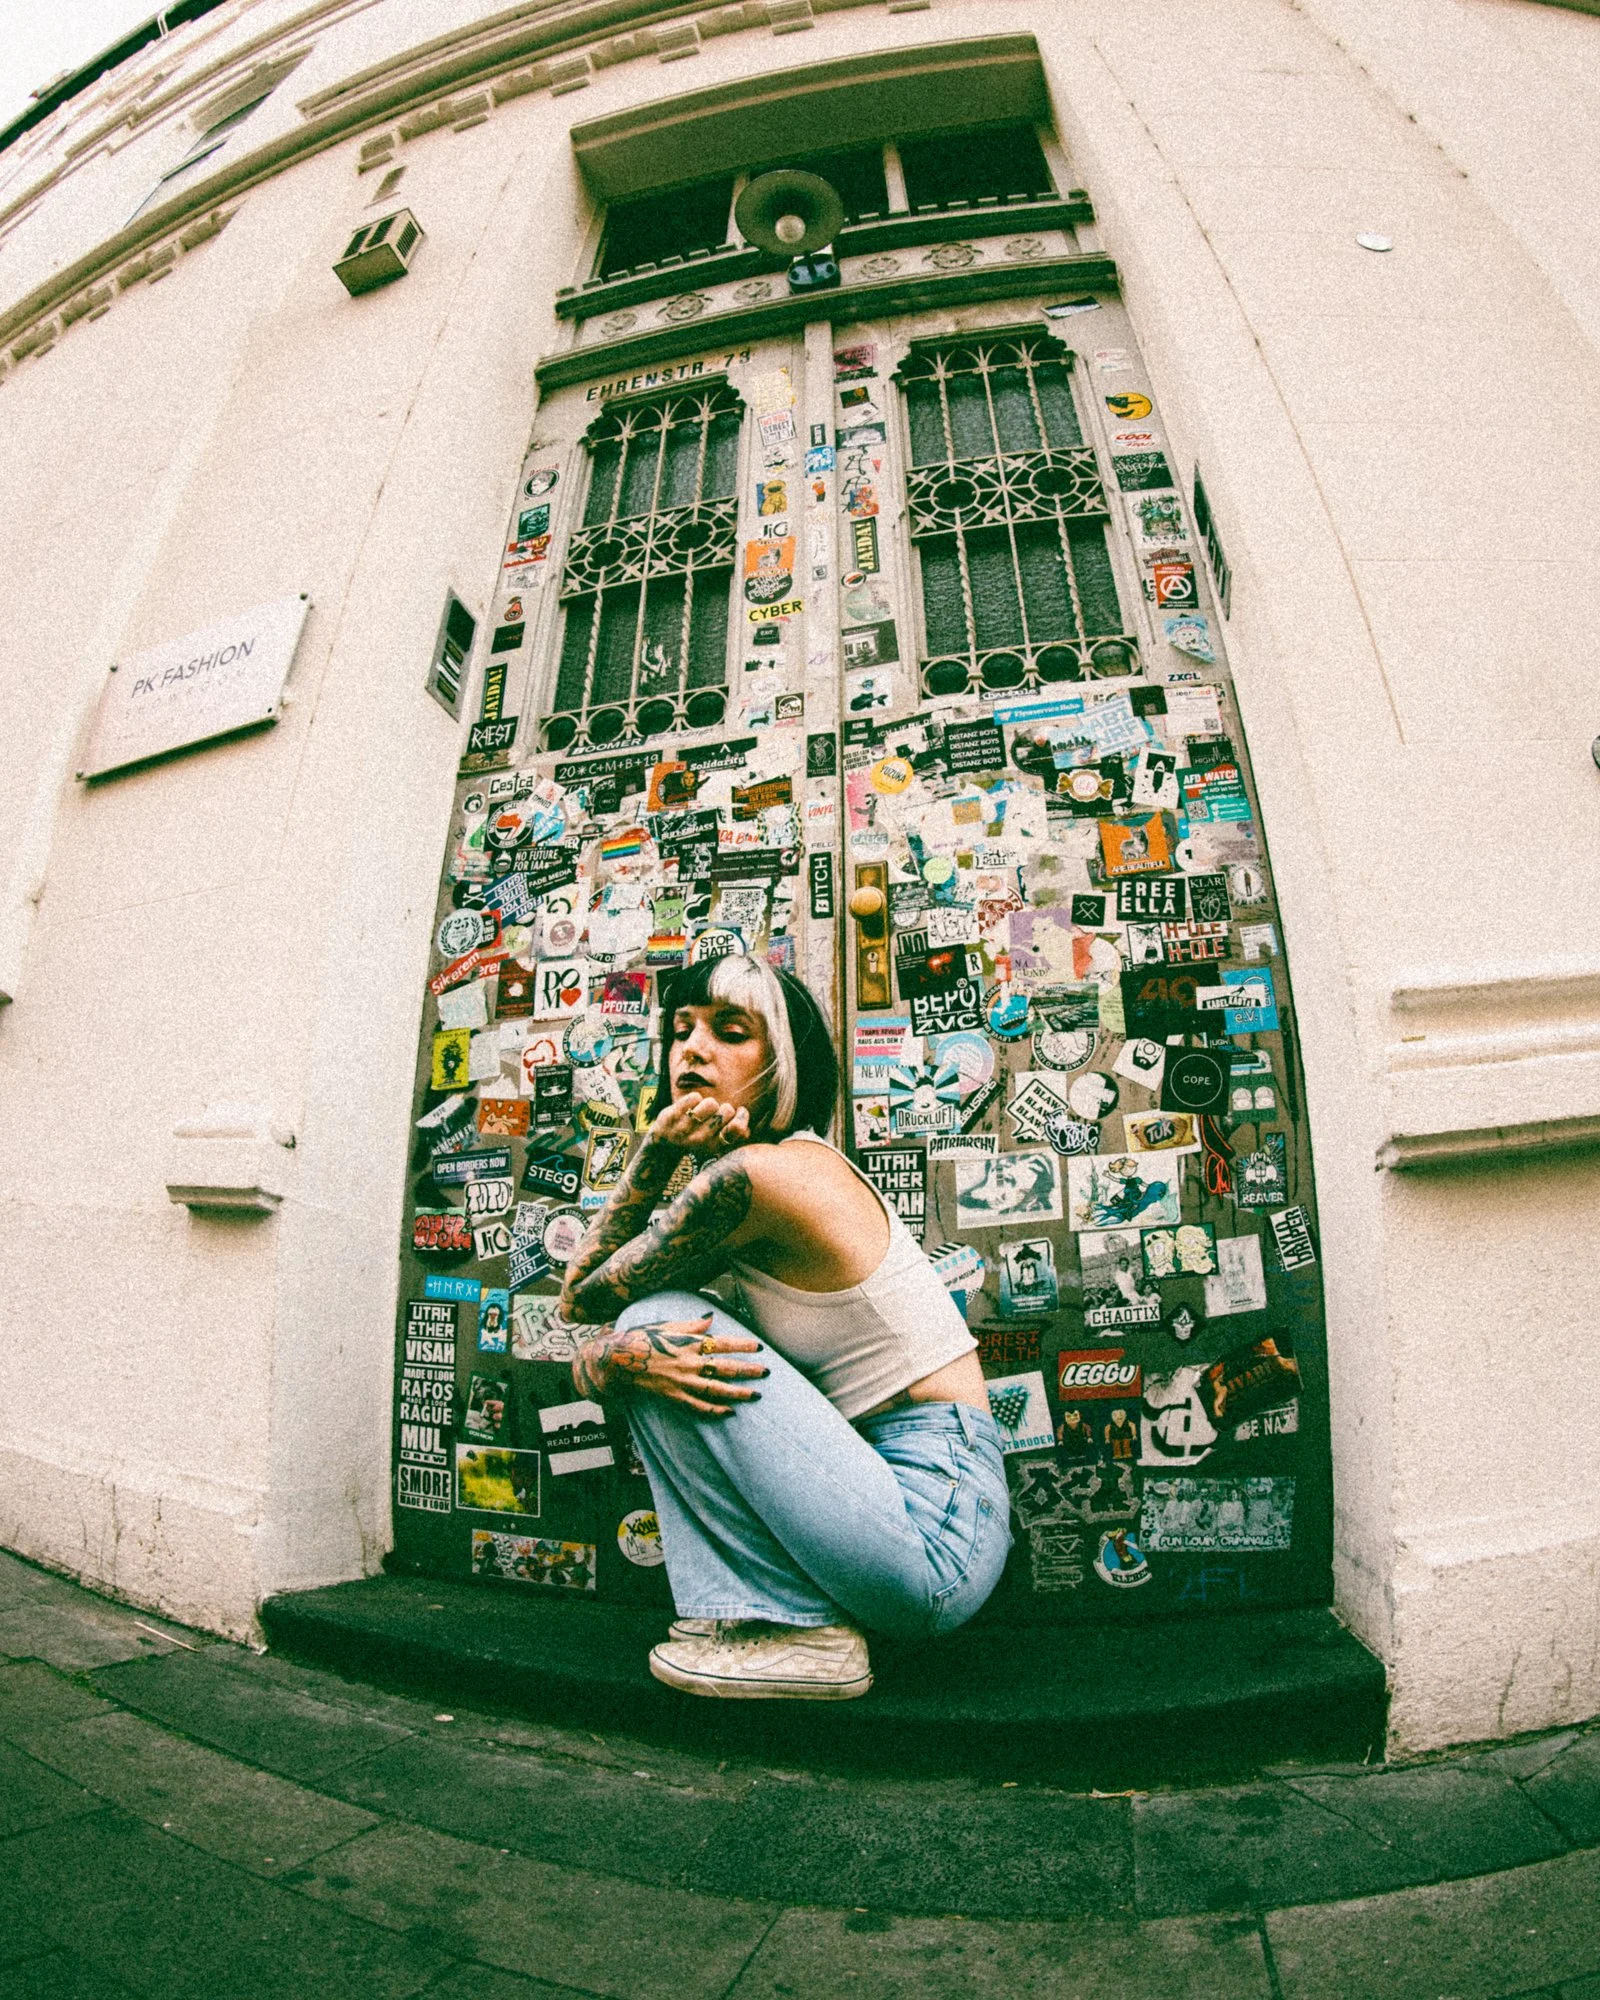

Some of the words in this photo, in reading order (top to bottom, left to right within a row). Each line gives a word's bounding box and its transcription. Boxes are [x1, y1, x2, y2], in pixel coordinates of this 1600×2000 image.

[586, 360, 713, 402] EHRENSTR.
[749, 600, 803, 622] CYBER
[131, 675, 161, 699] PK
[160, 638, 256, 688] FASHION
[980, 728, 999, 737] BOYS
[571, 737, 643, 756] BOOMER
[980, 738, 1000, 747] BOYS
[981, 747, 1001, 756] BOYS
[689, 754, 746, 772] Solidarity
[982, 756, 1002, 765] BOYS
[1204, 769, 1239, 783] WATCH
[515, 851, 527, 862] NO
[529, 849, 559, 861] FUTURE
[513, 861, 529, 871] FOR
[528, 876, 547, 888] FADE
[548, 867, 572, 882] MEDIA
[1189, 875, 1226, 889] KLAR!
[1121, 881, 1176, 898] FREE
[1120, 898, 1176, 914] ELLA
[700, 934, 735, 948] STOP
[700, 944, 735, 960] HATE
[1182, 1075, 1211, 1086] COPE
[898, 1105, 954, 1127] DRUCKLUFT
[929, 1136, 997, 1156] PATRIARCHY
[436, 1161, 455, 1174] OPEN
[456, 1159, 489, 1173] BORDERS
[489, 1157, 507, 1169] NOW
[868, 1154, 918, 1172] UTAH
[412, 1305, 450, 1321] UTAH
[1092, 1306, 1160, 1325] CHAOTIX
[407, 1321, 454, 1338] ETHER
[405, 1339, 455, 1364] VISAH
[979, 1347, 1041, 1363] EALTH
[403, 1367, 426, 1380] MADE
[434, 1370, 455, 1382] LOOK
[401, 1379, 453, 1401] RAFOS
[400, 1402, 453, 1426] RAGUE
[401, 1423, 447, 1454] MUL
[546, 1437, 570, 1448] READ
[402, 1452, 446, 1465] CREW
[400, 1465, 451, 1499] SMORE
[400, 1494, 422, 1508] MADE
[429, 1497, 451, 1512] LOOK
[1159, 1535, 1183, 1547] FUN
[1218, 1534, 1275, 1547] CRIMINALS
